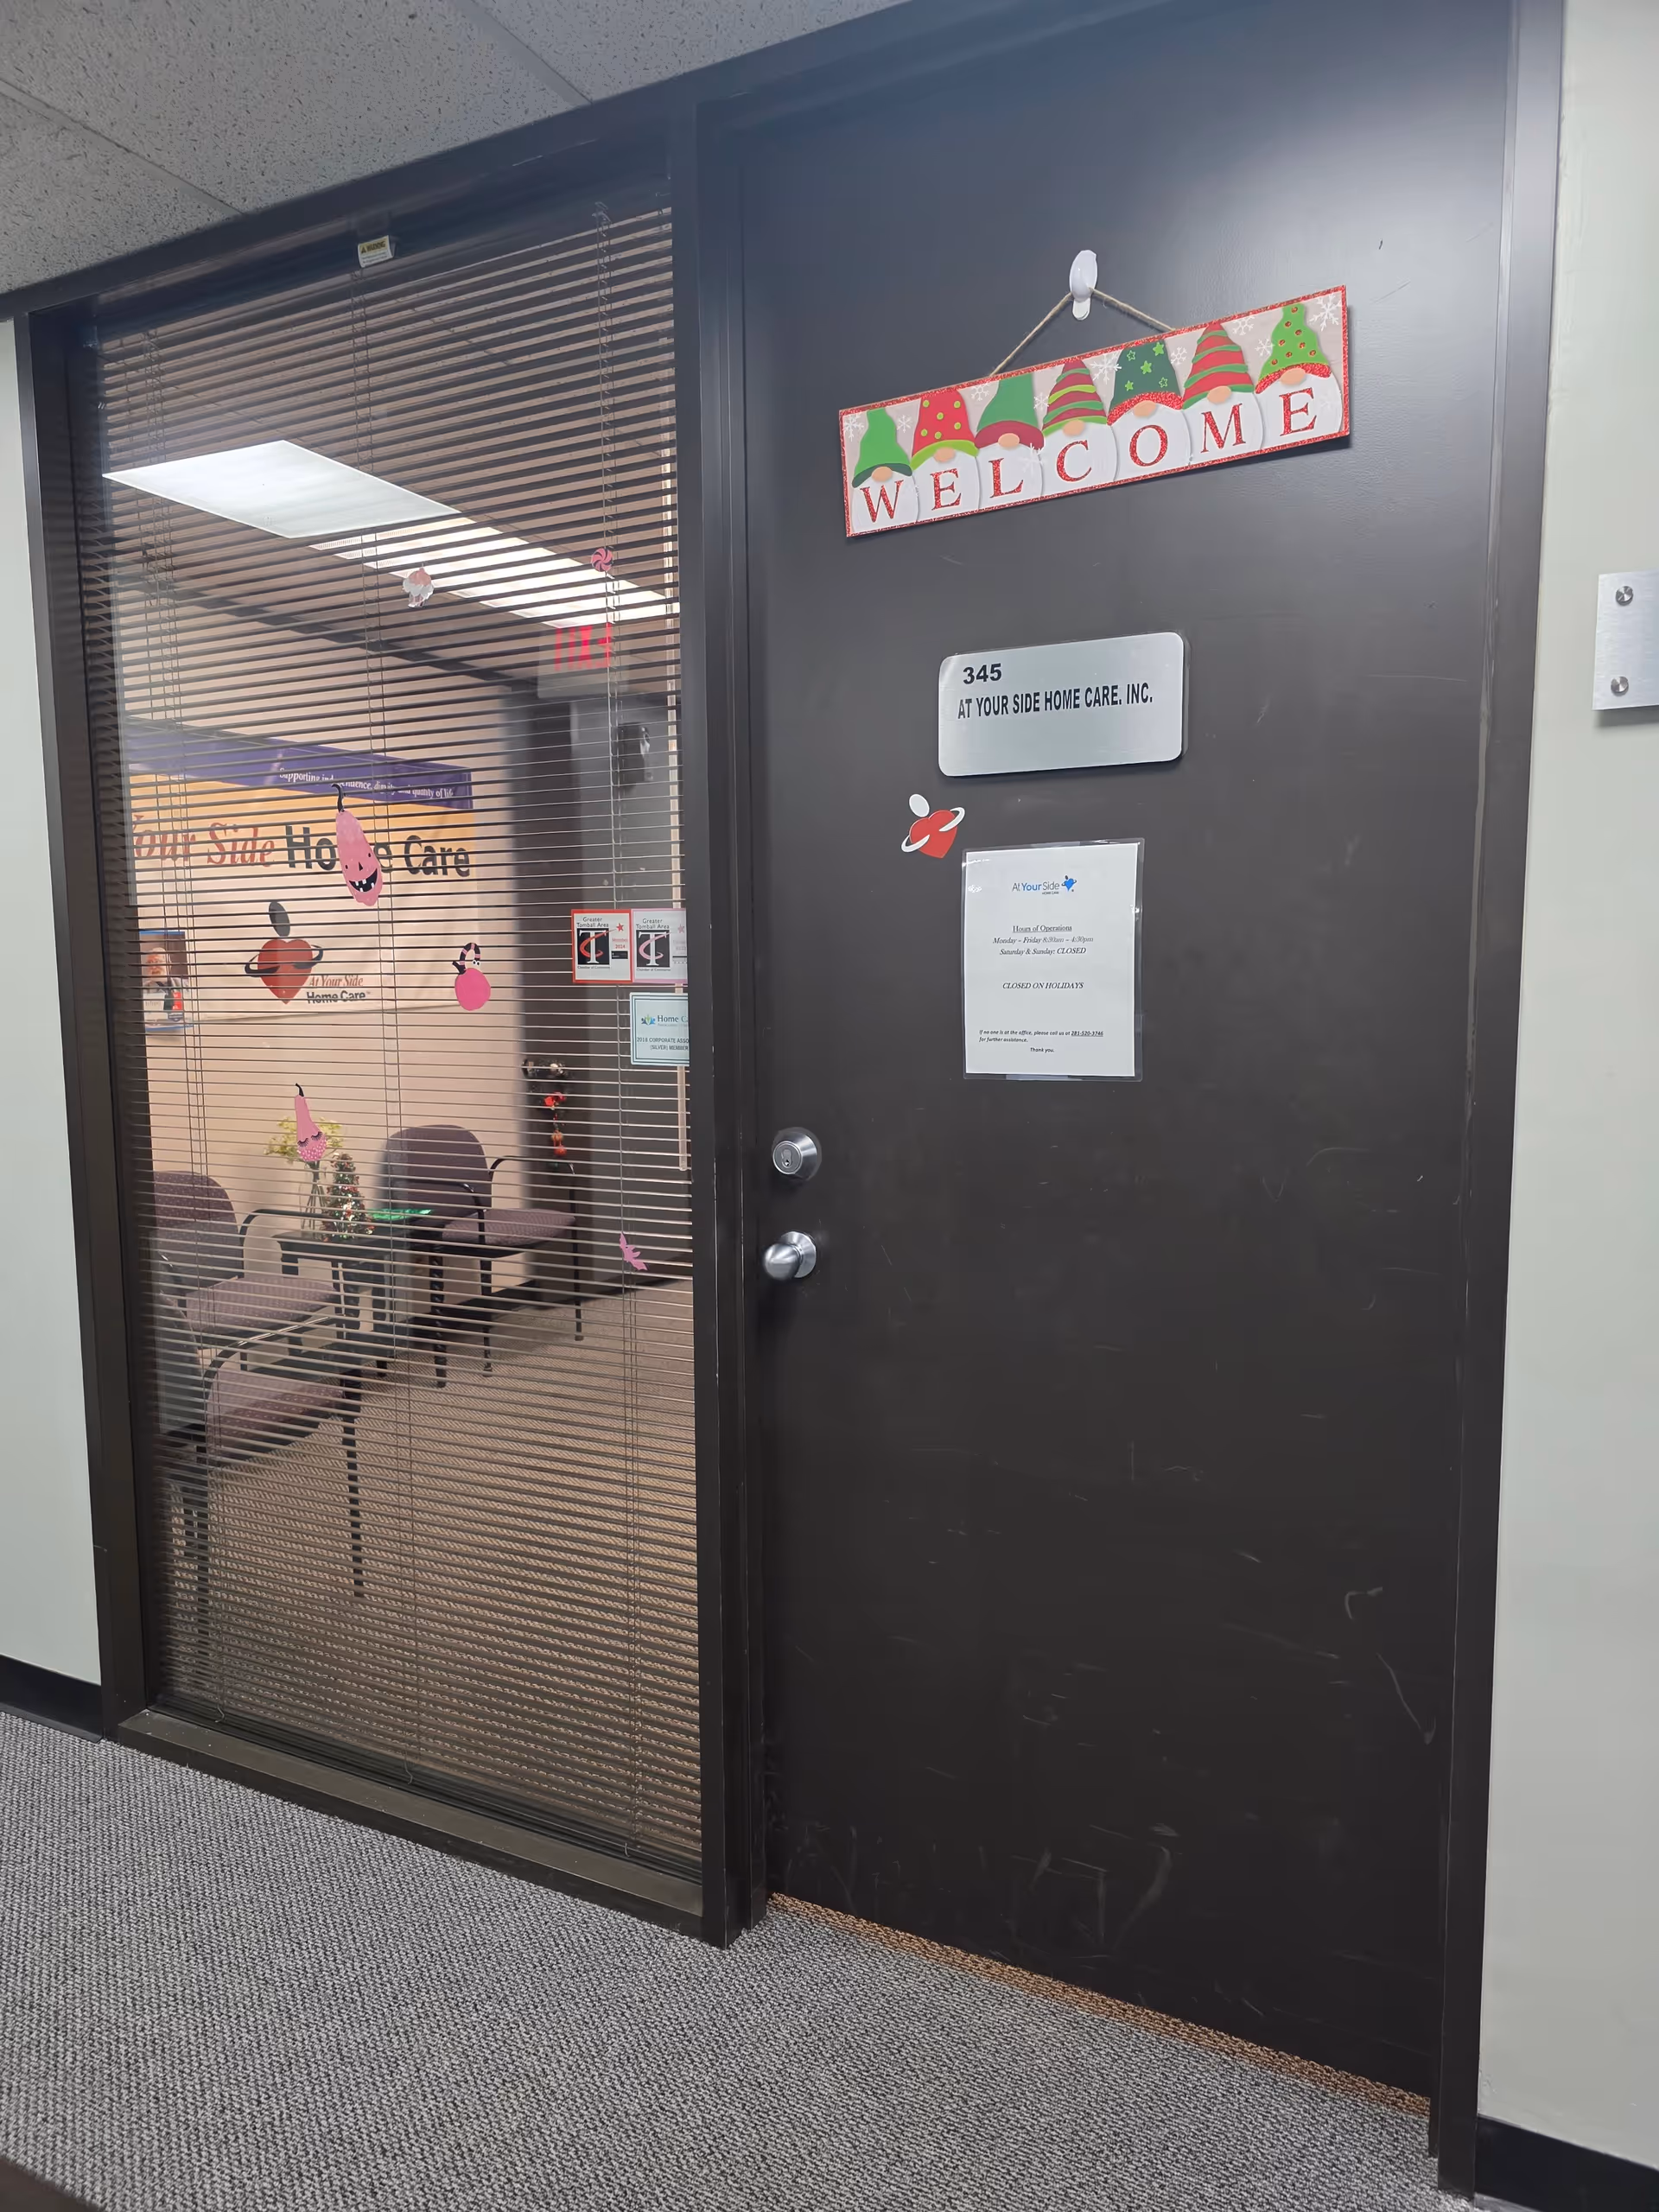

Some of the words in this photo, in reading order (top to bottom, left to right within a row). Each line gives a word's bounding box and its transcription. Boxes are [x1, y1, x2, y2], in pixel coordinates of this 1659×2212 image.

[860, 385, 1317, 524] WELCOME
[963, 663, 1002, 684] 345
[957, 698, 973, 719] AT
[976, 696, 1009, 717] YOUR
[1013, 692, 1040, 714] SIDE
[1044, 688, 1081, 711] HOME
[1127, 682, 1154, 704] INC.
[207, 822, 275, 868] Side
[285, 824, 393, 874] Hoe
[404, 835, 471, 877] Care
[1012, 882, 1020, 892] At
[1020, 882, 1042, 892] Your
[1042, 881, 1060, 891] Side
[1039, 925, 1072, 933] Operations
[309, 976, 319, 987] At
[321, 975, 342, 987] Your
[344, 975, 364, 987] Side
[306, 991, 339, 1004] Home
